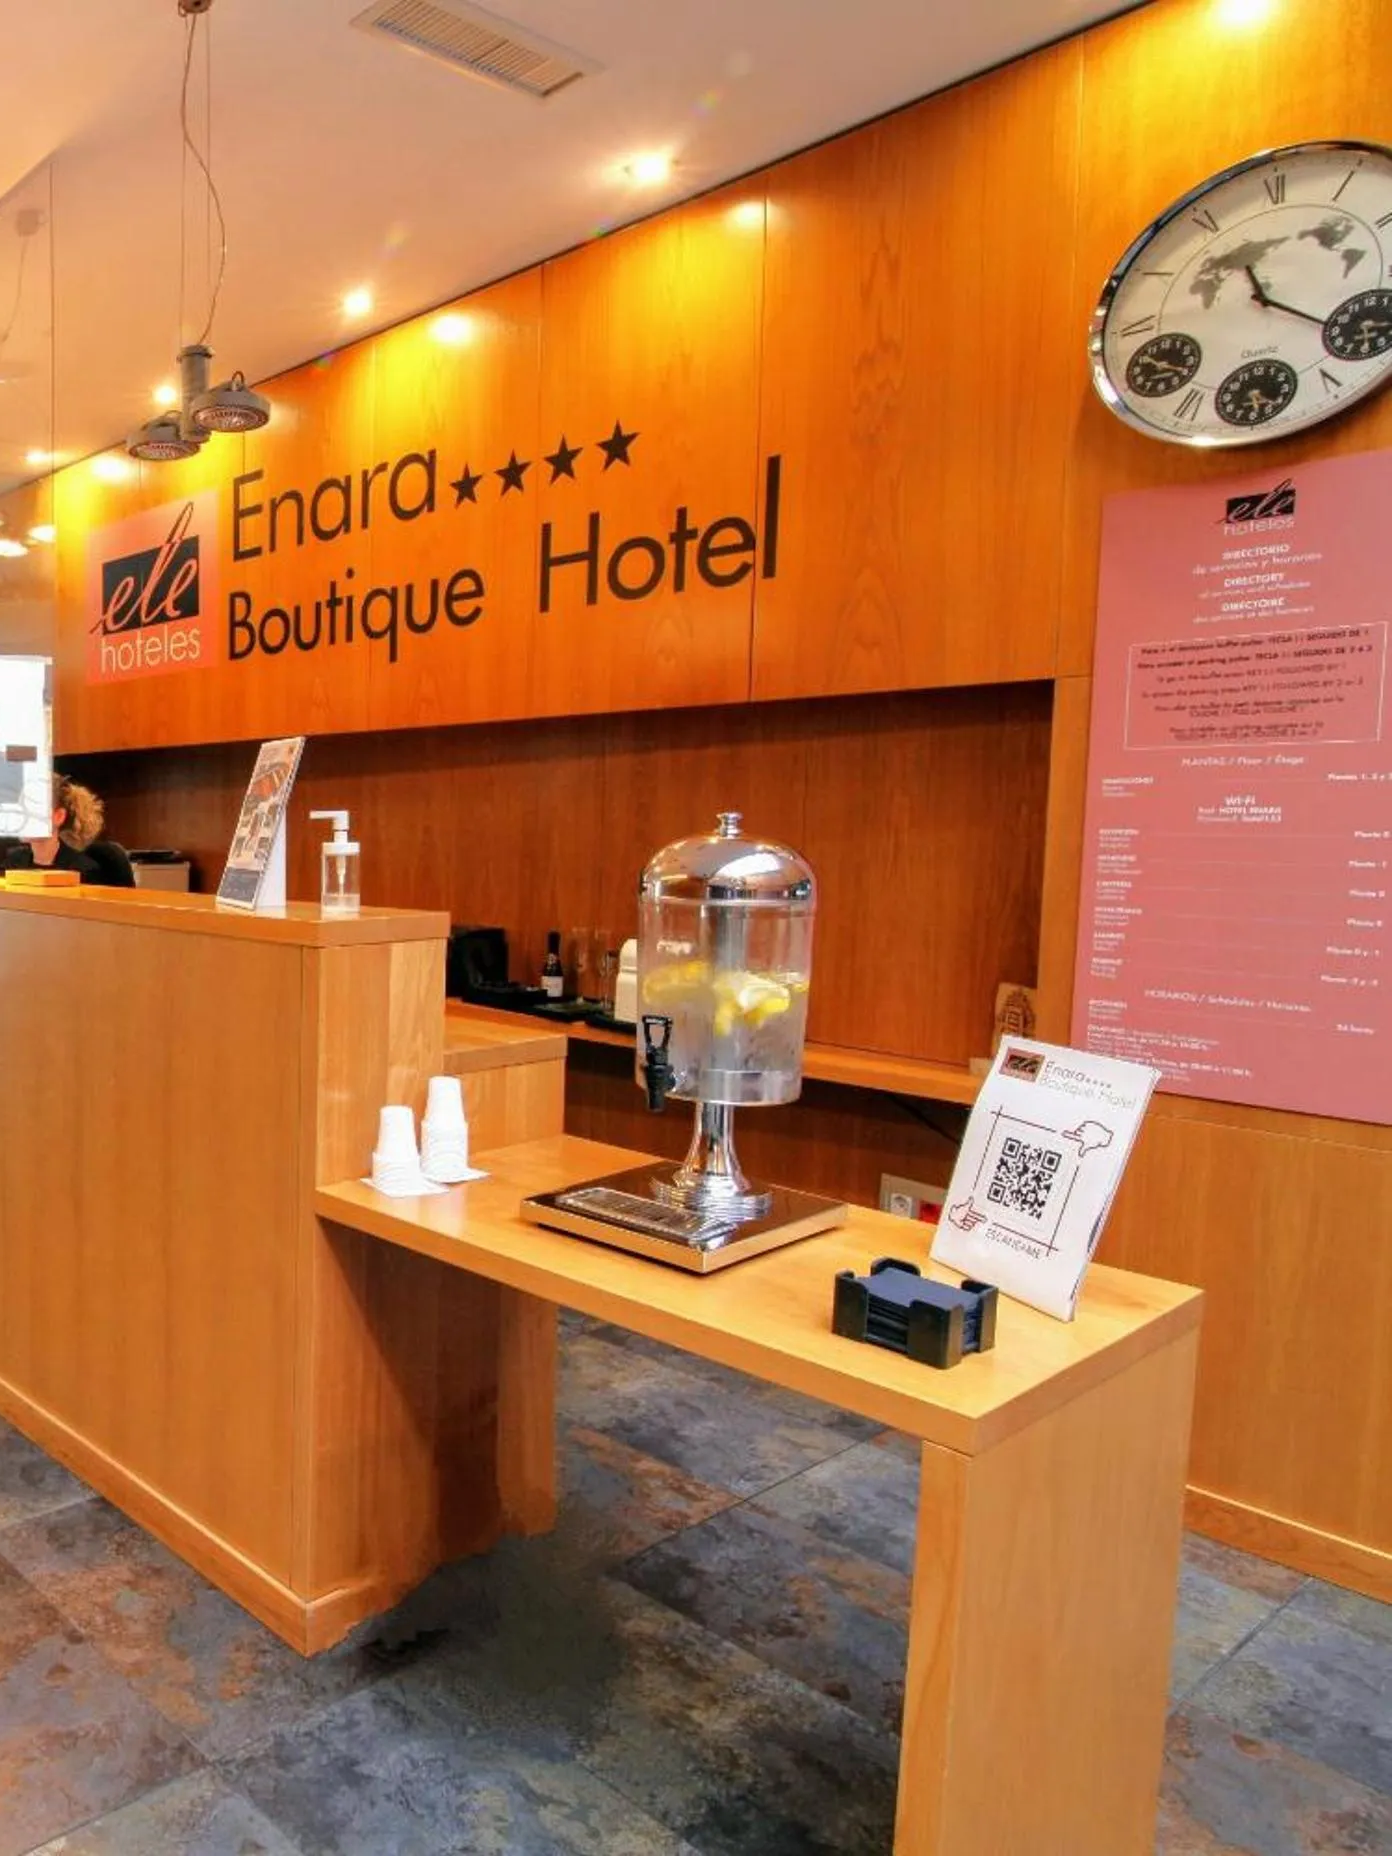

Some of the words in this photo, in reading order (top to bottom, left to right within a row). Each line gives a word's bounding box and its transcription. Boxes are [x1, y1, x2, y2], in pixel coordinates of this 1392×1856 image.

[228, 567, 484, 663] Boutique
[539, 454, 781, 613] Hotel
[233, 449, 437, 562] Enara
[1223, 515, 1295, 536] hoteles
[90, 502, 198, 632] ele
[100, 623, 201, 674] hoteles
